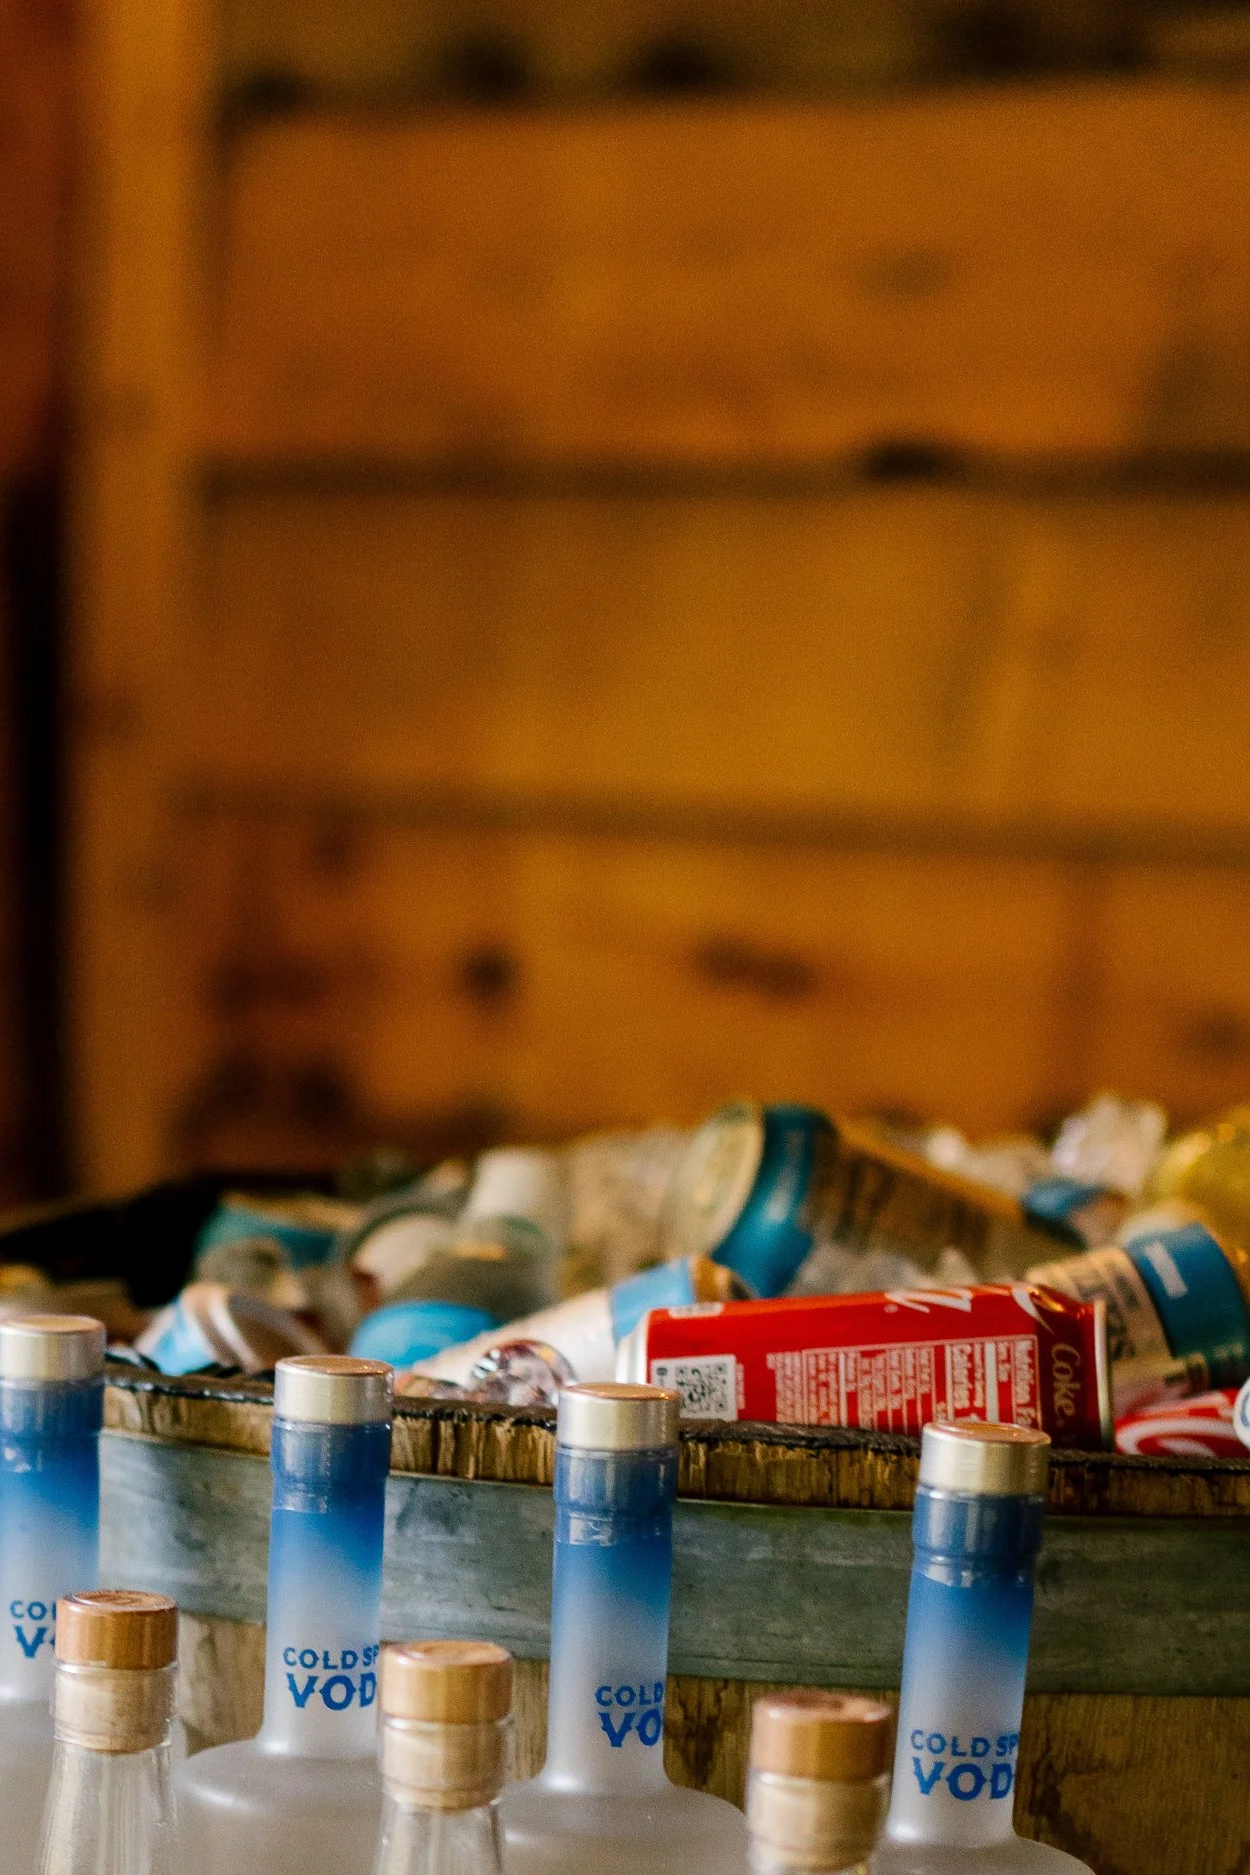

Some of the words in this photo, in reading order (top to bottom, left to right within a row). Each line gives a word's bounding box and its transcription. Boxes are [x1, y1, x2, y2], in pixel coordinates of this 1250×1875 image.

[1050, 1343, 1083, 1423] Coke
[9, 1599, 56, 1621] CO
[14, 1625, 56, 1658] V
[283, 1646, 358, 1669] COLD
[594, 1681, 664, 1707] COLD
[910, 1729, 991, 1758] COLD
